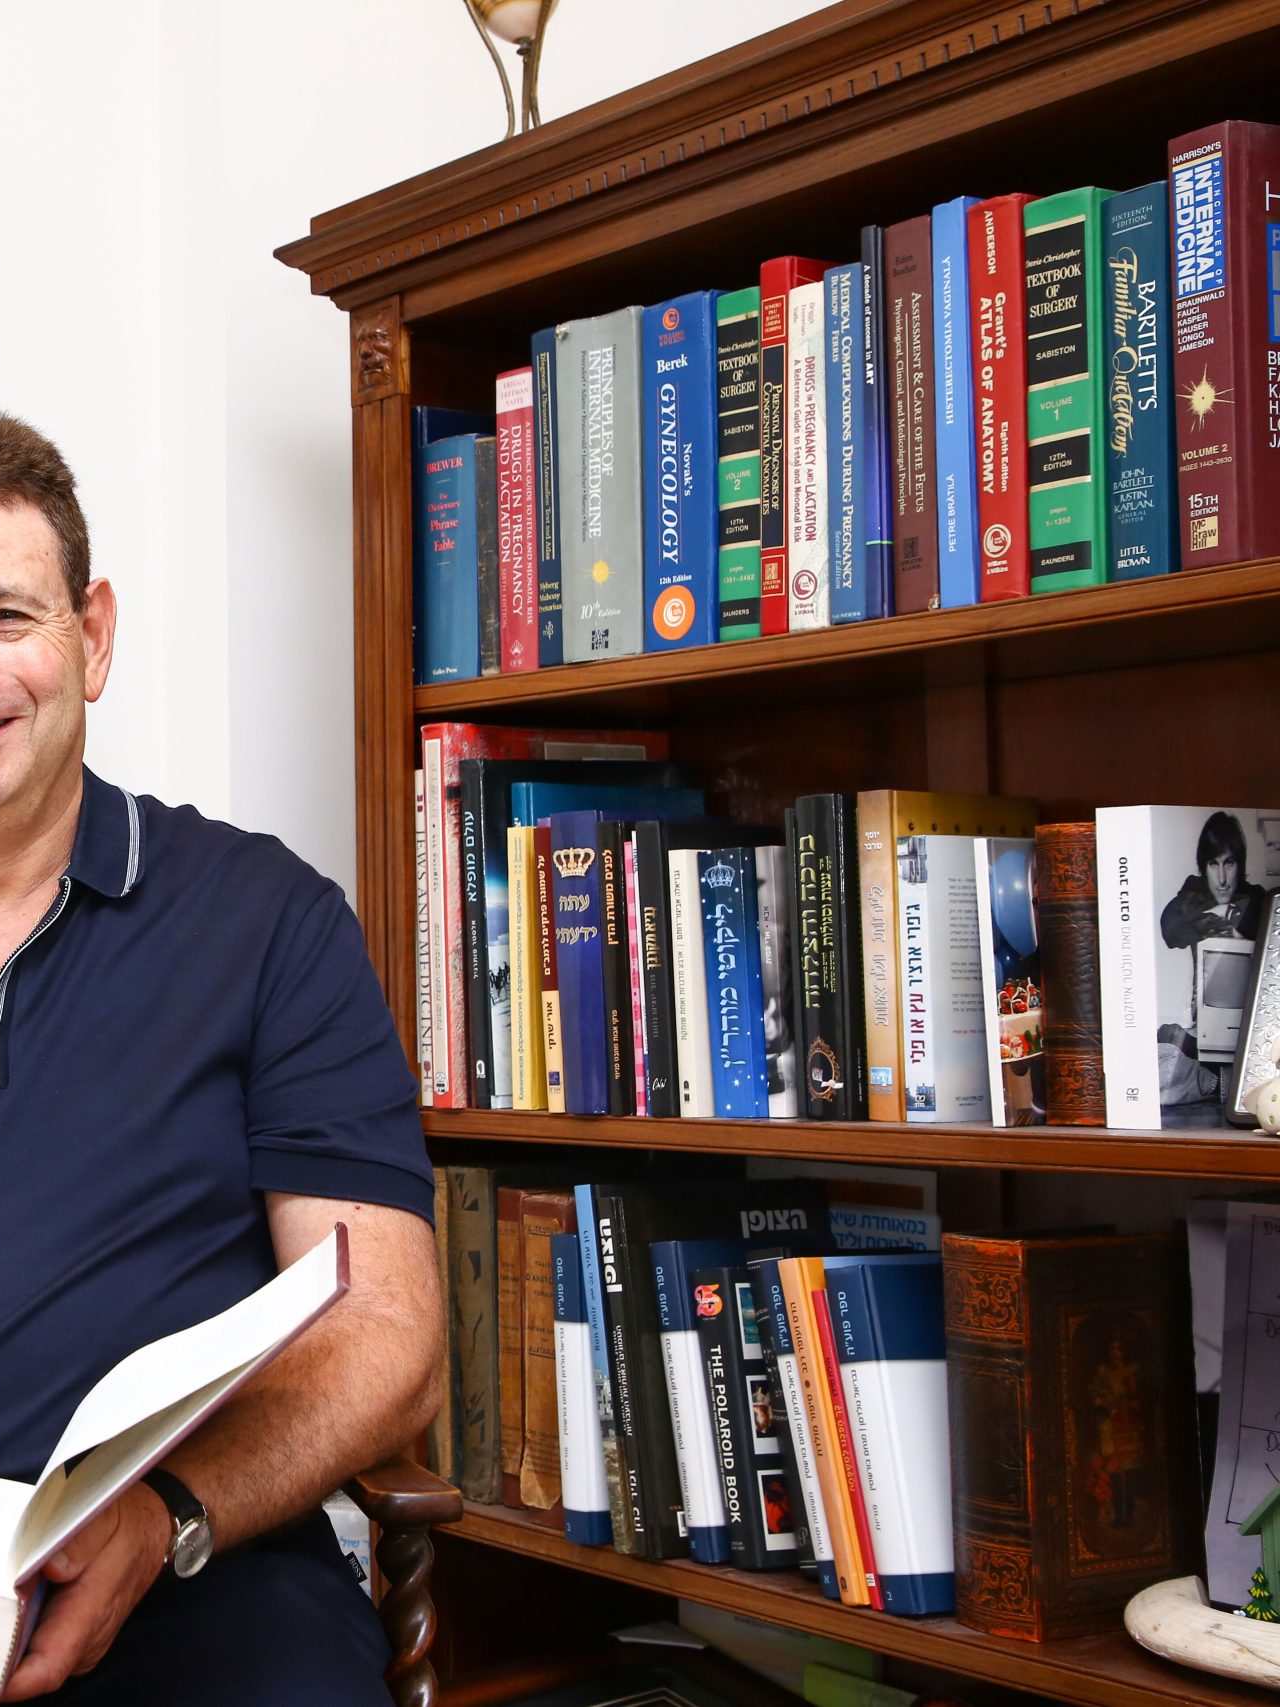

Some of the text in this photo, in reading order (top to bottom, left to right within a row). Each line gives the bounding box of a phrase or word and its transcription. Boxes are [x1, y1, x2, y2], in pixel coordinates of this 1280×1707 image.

[1172, 141, 1222, 166] HARRISON'S
[1111, 204, 1153, 223] SIXTEENTH
[1116, 214, 1147, 229] EDITION
[1212, 160, 1224, 285] PRINCIPLES OF
[1174, 169, 1196, 297] MEDICINE
[1194, 162, 1216, 293] INTERNAL
[984, 209, 997, 276] ANDERSON
[1026, 263, 1082, 289] TEXTBOOK
[1045, 284, 1061, 299] OF
[1108, 246, 1138, 347] Familiar
[1176, 290, 1226, 311] BRAUNWALD
[1029, 294, 1078, 319] SURGERY
[1176, 307, 1200, 319] FAUCI
[864, 264, 874, 385] A decade of success in ART
[994, 291, 1009, 361] Grant's
[1177, 313, 1208, 327] KASPER
[1177, 321, 1210, 337] HAUSER
[1136, 279, 1158, 411] BARTLETT'S
[1177, 331, 1205, 345] LONGO
[1177, 337, 1215, 354] JAMESON
[656, 354, 689, 374] Berek
[718, 352, 759, 373] TEXTBOOK
[1036, 344, 1076, 361] SABISTON
[732, 369, 745, 382] OF
[804, 355, 816, 393] DRUGS
[943, 320, 954, 425] HISTERECTOMIA
[720, 380, 757, 399] SURGERY
[980, 296, 995, 495] ATLAS OF ANATOMY
[601, 346, 614, 477] PRINCIPLES OF
[911, 291, 926, 513] ASSESSMENT & CARE OF THE FETUS
[1040, 396, 1073, 411] VOLUME
[1053, 409, 1060, 421] 1
[723, 424, 755, 437] SABISTON
[804, 403, 817, 466] PREGNANCY
[839, 271, 854, 590] MEDICAL COMPLICATIONS DURING PREGNANCY
[500, 427, 510, 465] AND
[588, 349, 602, 539] INTERNAL MEDICINE
[762, 381, 772, 516] CONGENITAL ANOMALIES
[771, 383, 784, 511] PRENATAL DIAGNOSIS OF
[1181, 443, 1229, 461] VOLUME 2
[426, 457, 463, 474] BREWER
[1000, 420, 1010, 493] Eighth Edition
[1042, 459, 1073, 473] EDITION
[1048, 452, 1067, 462] 12TH
[1179, 461, 1199, 473] PAGES
[660, 383, 679, 566] GYNECOLOGY
[683, 442, 694, 497] Novak's
[725, 469, 752, 481] VOLUME
[1120, 468, 1145, 480] JOHN
[734, 480, 741, 491] 2
[1113, 475, 1155, 491] BARTLETT
[1120, 490, 1148, 503] JUSTIN
[1187, 492, 1219, 510] 15TH
[500, 470, 511, 563] LACTATION
[511, 425, 524, 616] DRUGS IN PREGNANCY
[729, 518, 745, 527] 12TH
[804, 484, 817, 542] LACTATION
[1190, 505, 1219, 518] EDITION
[430, 518, 458, 532] Phrase
[725, 524, 749, 535] EDITION
[948, 518, 957, 553] PETRE
[1191, 518, 1207, 531] Mc
[1191, 528, 1218, 543] Graw
[433, 539, 455, 552] Fable
[1120, 544, 1149, 558] LITTLE
[1192, 538, 1208, 550] Hill
[1040, 554, 1075, 567] SAUNDERS
[1117, 556, 1151, 569] BROWN
[672, 573, 693, 584] Edition
[598, 606, 621, 617] Edition
[416, 829, 427, 882] JEWS
[463, 811, 477, 903] עולם מופלא
[536, 855, 546, 869] על
[1118, 857, 1129, 886] סטיב
[538, 870, 548, 902] שמונה
[601, 848, 619, 945] לפנים משורת הדין
[820, 872, 832, 900] עצות
[418, 887, 429, 933] AND
[559, 893, 591, 912] עתה
[540, 903, 550, 936] פרקים
[798, 834, 821, 1009] ברכה והצלחה
[819, 903, 834, 947] וסגולות
[555, 925, 598, 945] ידעתי
[705, 903, 741, 980] ליקוטי
[1121, 926, 1132, 950] מאת
[419, 939, 434, 1055] MEDICINE
[546, 1000, 555, 1018] אורי
[909, 992, 926, 1064] עץ או פלי
[740, 1208, 808, 1239] הצופן
[598, 1218, 623, 1293] הצופן
[556, 1257, 564, 1280] ספר
[655, 1266, 665, 1290] ספר
[770, 1285, 781, 1310] ספר
[837, 1290, 849, 1318] ספר
[710, 1345, 742, 1523] THE POLAROID BOOK
[628, 1469, 644, 1532] זמיר כהן
[348, 1557, 364, 1578] BOSS
